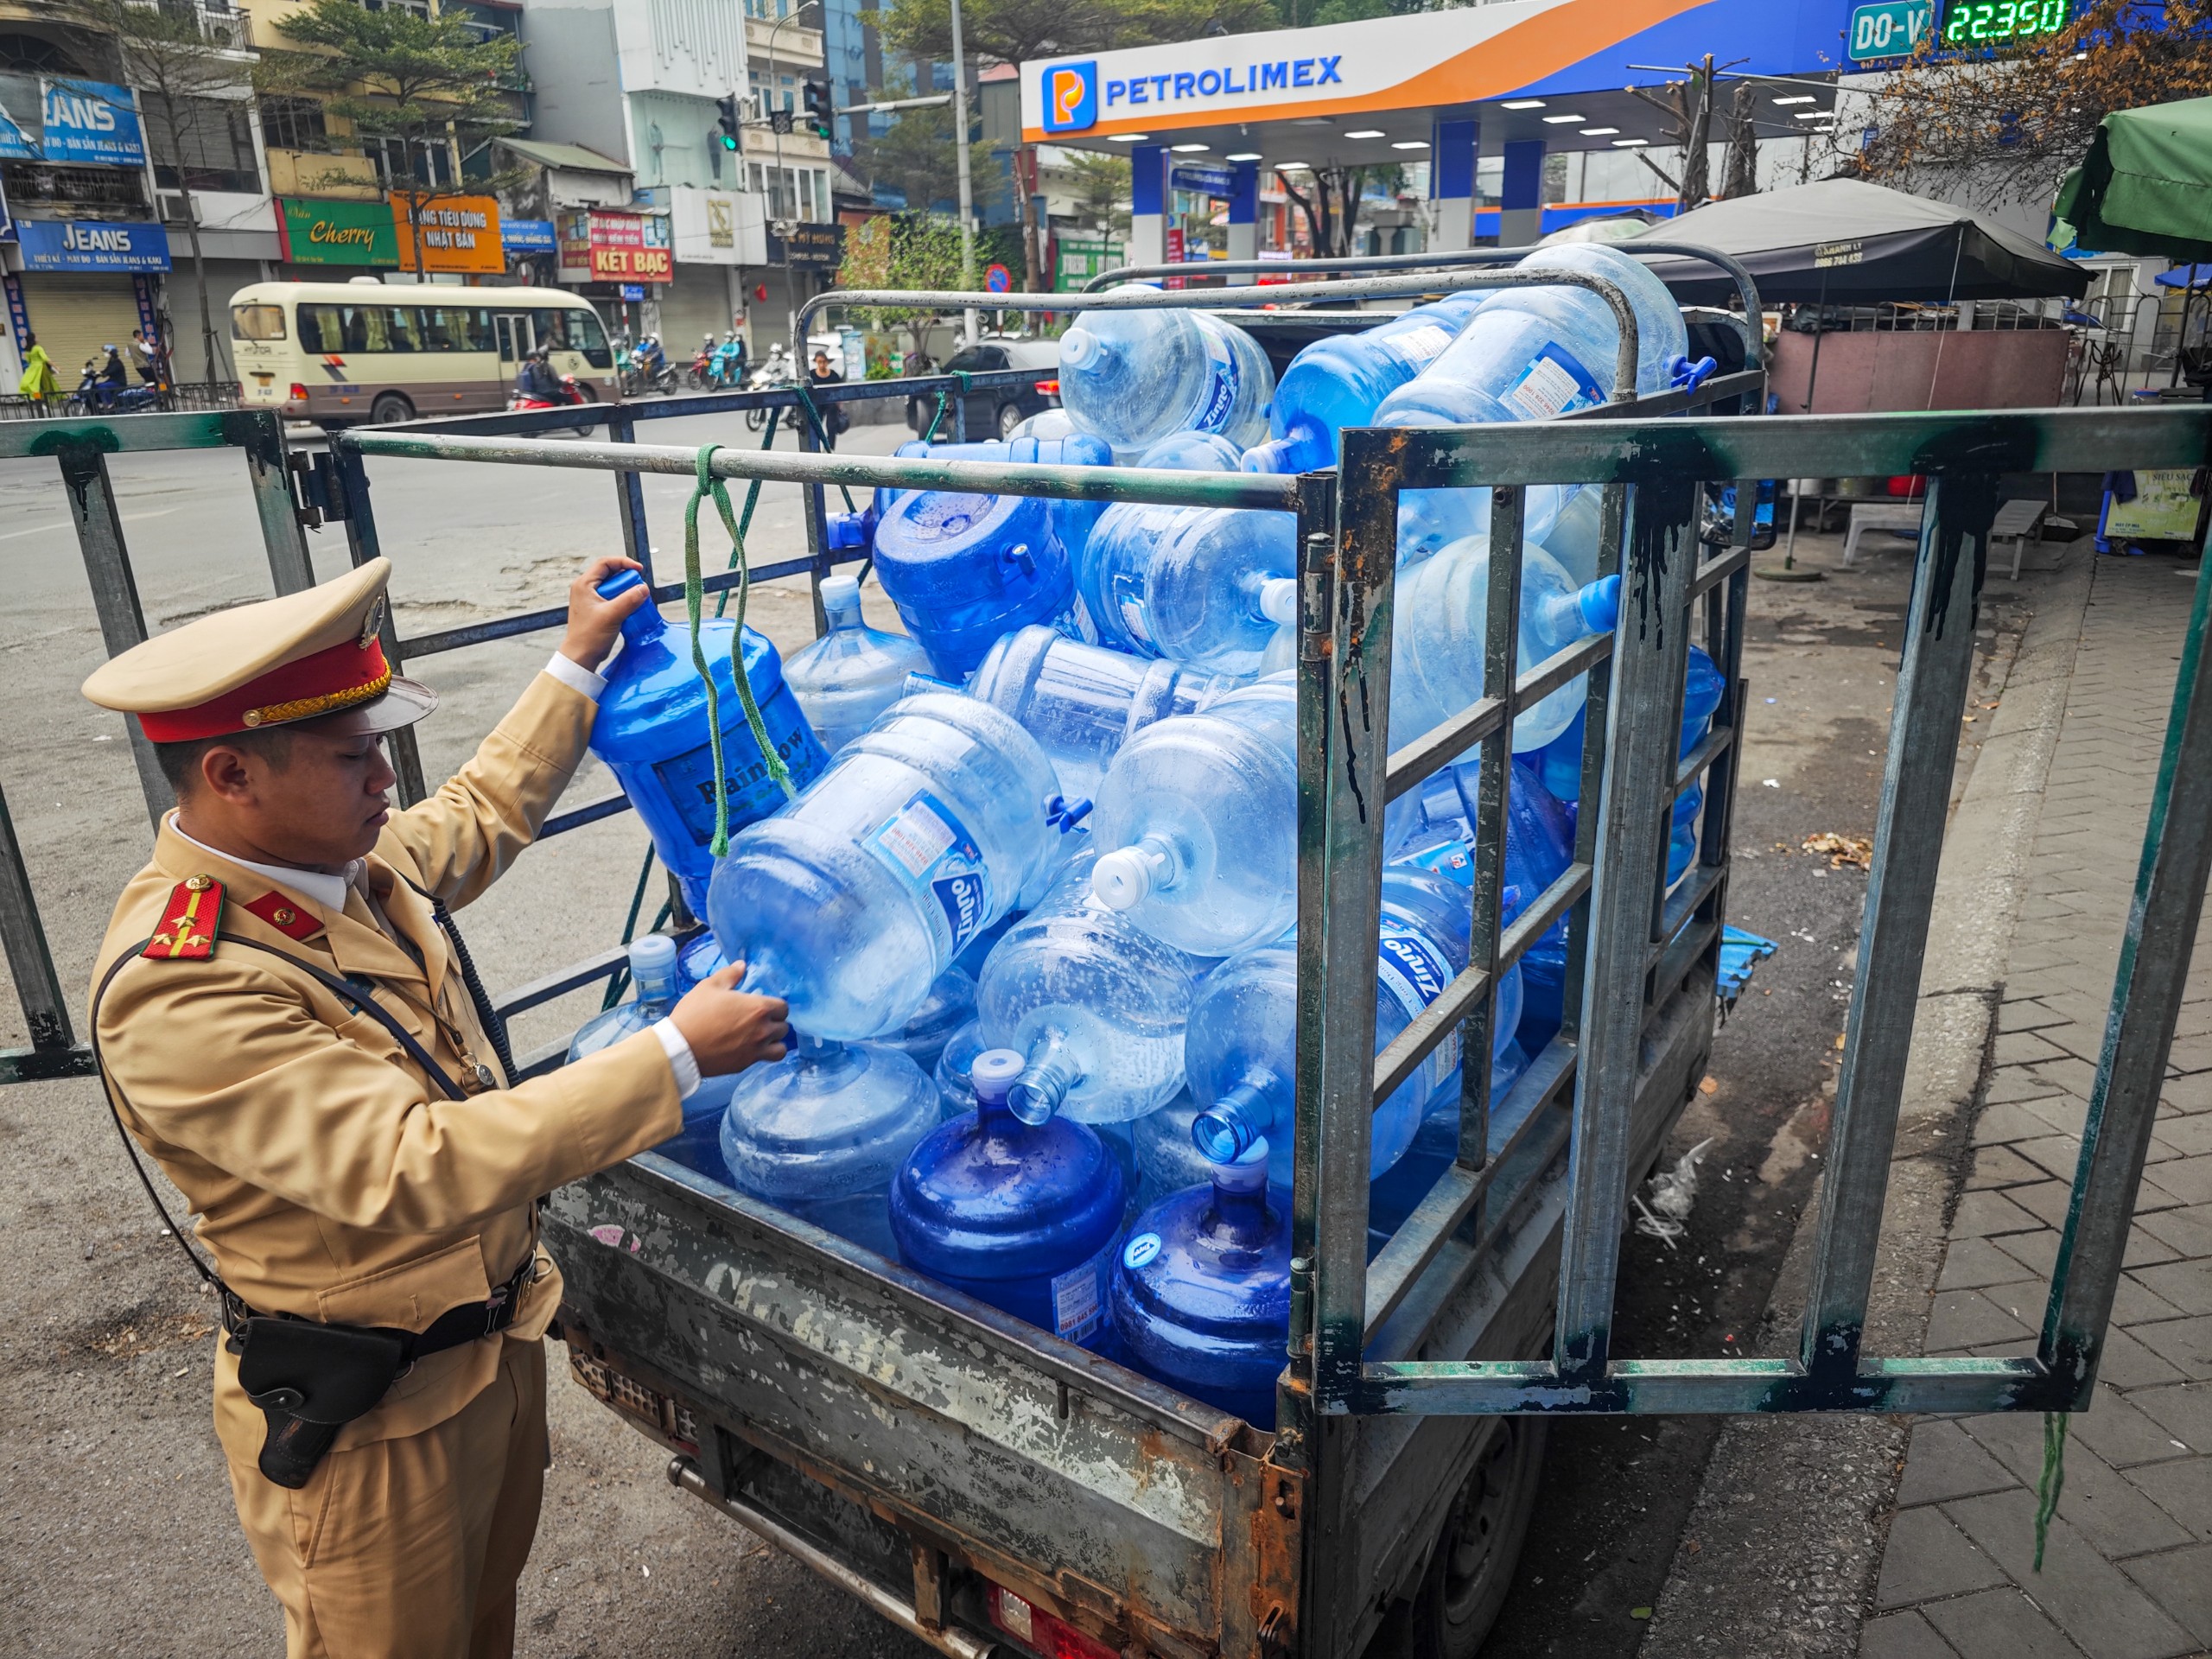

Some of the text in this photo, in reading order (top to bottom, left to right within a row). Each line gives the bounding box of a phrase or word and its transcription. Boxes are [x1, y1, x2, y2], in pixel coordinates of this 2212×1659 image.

[1855, 9, 1926, 50] DO-V
[1106, 55, 1342, 106] PETROLIMEX
[62, 224, 131, 251] JEANS
[310, 220, 375, 252] Cherry
[425, 228, 475, 251] NHẬT BẢN
[596, 246, 628, 272] KÉT
[633, 251, 668, 276] BẠC
[1203, 384, 1228, 427] Zinno
[696, 726, 804, 805] Rainow
[951, 879, 976, 943] Zinno
[1384, 938, 1442, 999] Zinno
[1060, 1319, 1076, 1332] 0981
[1077, 1312, 1088, 1323] 845
